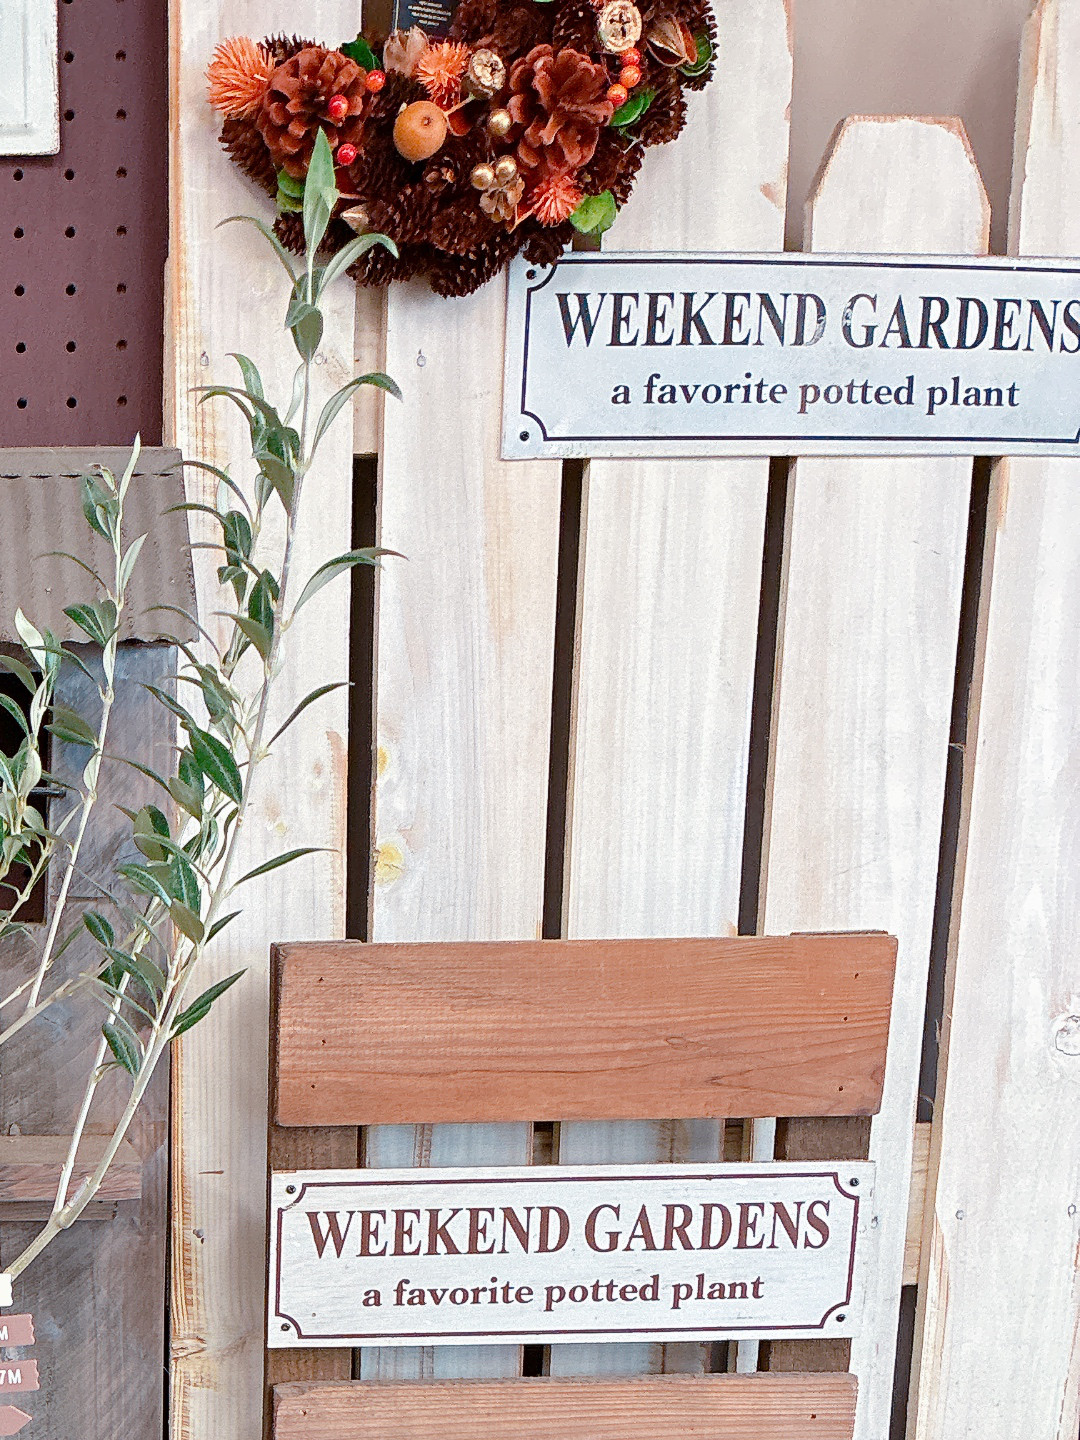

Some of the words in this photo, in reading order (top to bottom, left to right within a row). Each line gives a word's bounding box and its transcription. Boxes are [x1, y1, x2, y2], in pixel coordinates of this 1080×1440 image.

[554, 291, 827, 349] WEEKEND
[841, 292, 1080, 354] GARDENS
[610, 383, 632, 405] a
[642, 371, 788, 405] favorite
[796, 374, 915, 415] potted
[925, 375, 1020, 416] plant
[304, 1205, 571, 1260] WEEKEND
[584, 1199, 831, 1253] GARDENS
[361, 1287, 382, 1307] a
[392, 1275, 534, 1307] favorite
[543, 1273, 660, 1312] potted
[670, 1272, 765, 1310] plant
